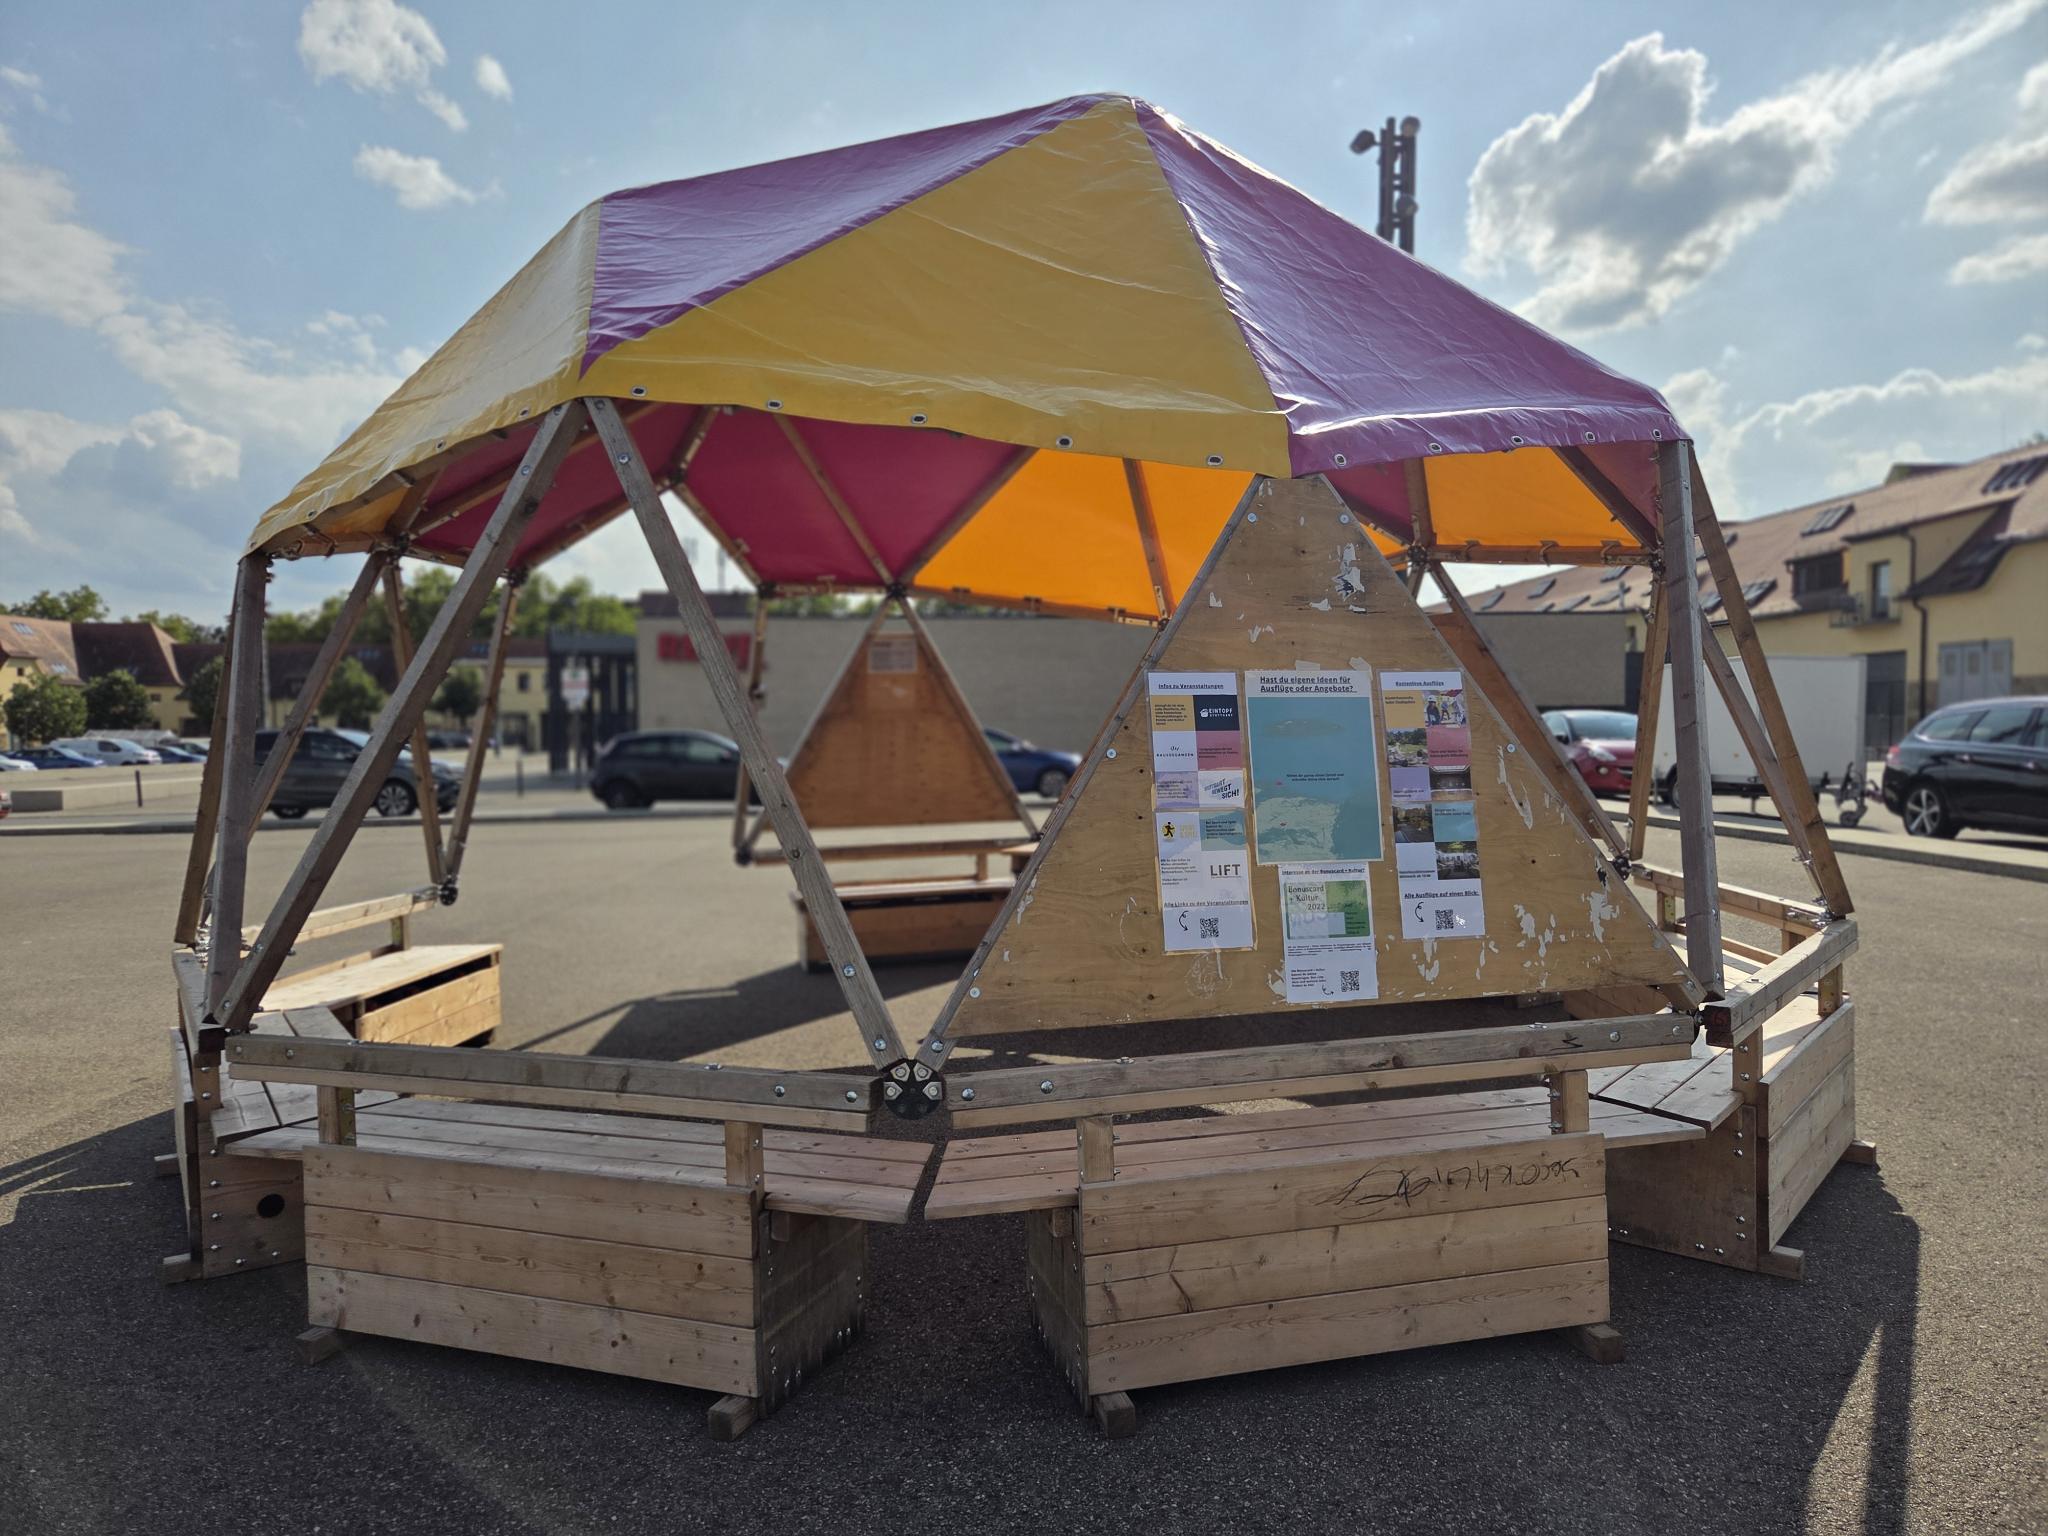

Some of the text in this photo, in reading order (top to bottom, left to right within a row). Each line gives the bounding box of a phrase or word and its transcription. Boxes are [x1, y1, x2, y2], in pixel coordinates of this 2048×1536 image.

[1260, 676, 1351, 686] Hast du eigene Ideen für
[1260, 685, 1294, 693] Ausflüge
[1315, 685, 1353, 693] Angebote?
[1221, 789, 1240, 799] SICH!
[1210, 864, 1241, 876] LIFT
[1288, 885, 1325, 893] Bonuscard
[1295, 894, 1319, 902] Kultur
[1416, 891, 1438, 899] Ausflüge
[1206, 900, 1249, 908] Veranstaltungen
[1307, 903, 1326, 911] 2022
